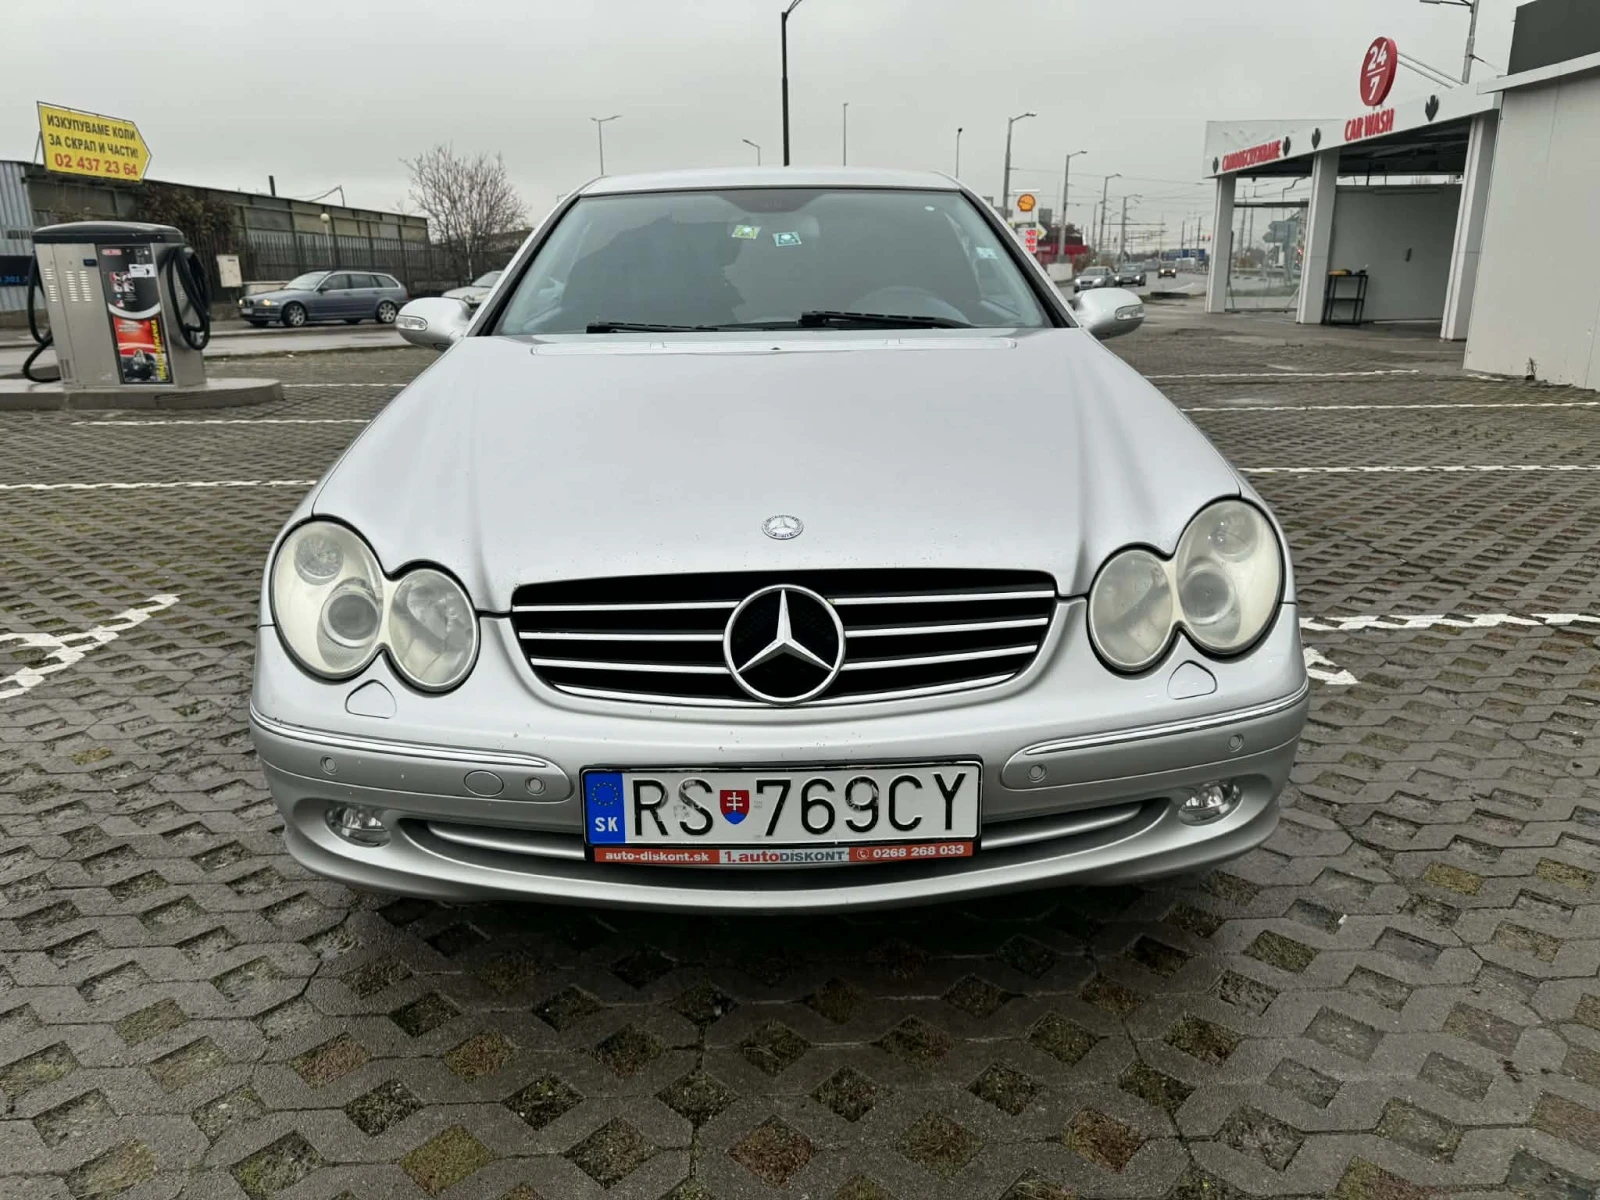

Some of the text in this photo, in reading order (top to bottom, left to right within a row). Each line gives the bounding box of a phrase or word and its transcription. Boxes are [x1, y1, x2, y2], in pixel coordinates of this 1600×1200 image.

[1367, 41, 1387, 71] 24
[1368, 75, 1381, 101] 7
[46, 114, 136, 141] ИЗКУПУВАМЕ КОЛИ
[1344, 108, 1395, 142] CAR WASH
[48, 134, 62, 146] ЗА
[65, 136, 97, 152] СКРАП
[98, 143, 106, 154] И
[54, 153, 138, 176] 02 437 23 64
[632, 773, 967, 837] RS 769CY
[594, 817, 618, 832] SK
[605, 850, 710, 862] auto-diskont.sk
[873, 844, 965, 859] 0268 268 033
